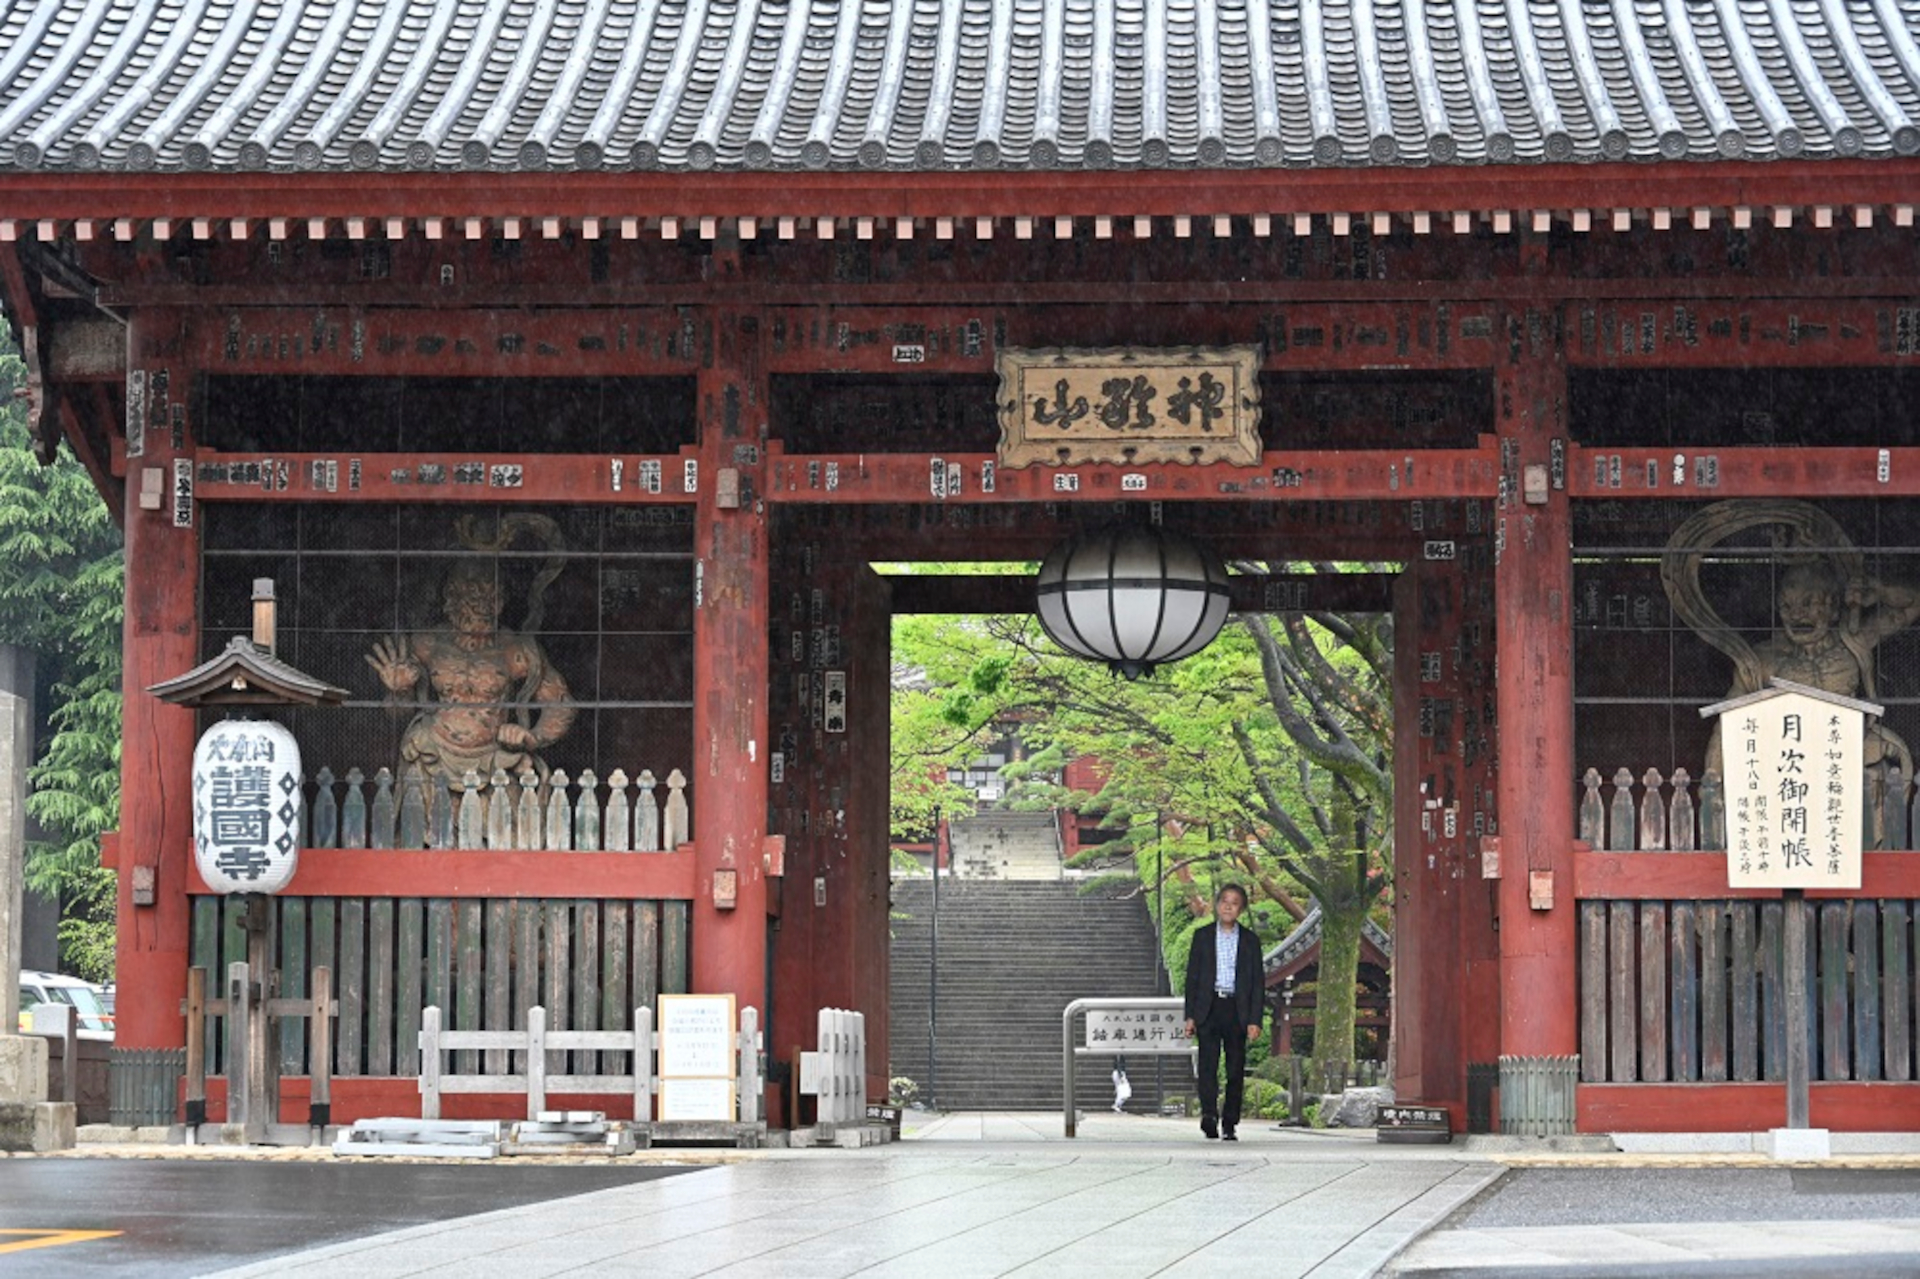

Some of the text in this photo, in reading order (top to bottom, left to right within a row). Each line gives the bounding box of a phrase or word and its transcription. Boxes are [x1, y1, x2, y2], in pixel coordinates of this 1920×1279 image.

[206, 733, 275, 763] 大本山
[1777, 714, 1813, 869] 月次御開帳
